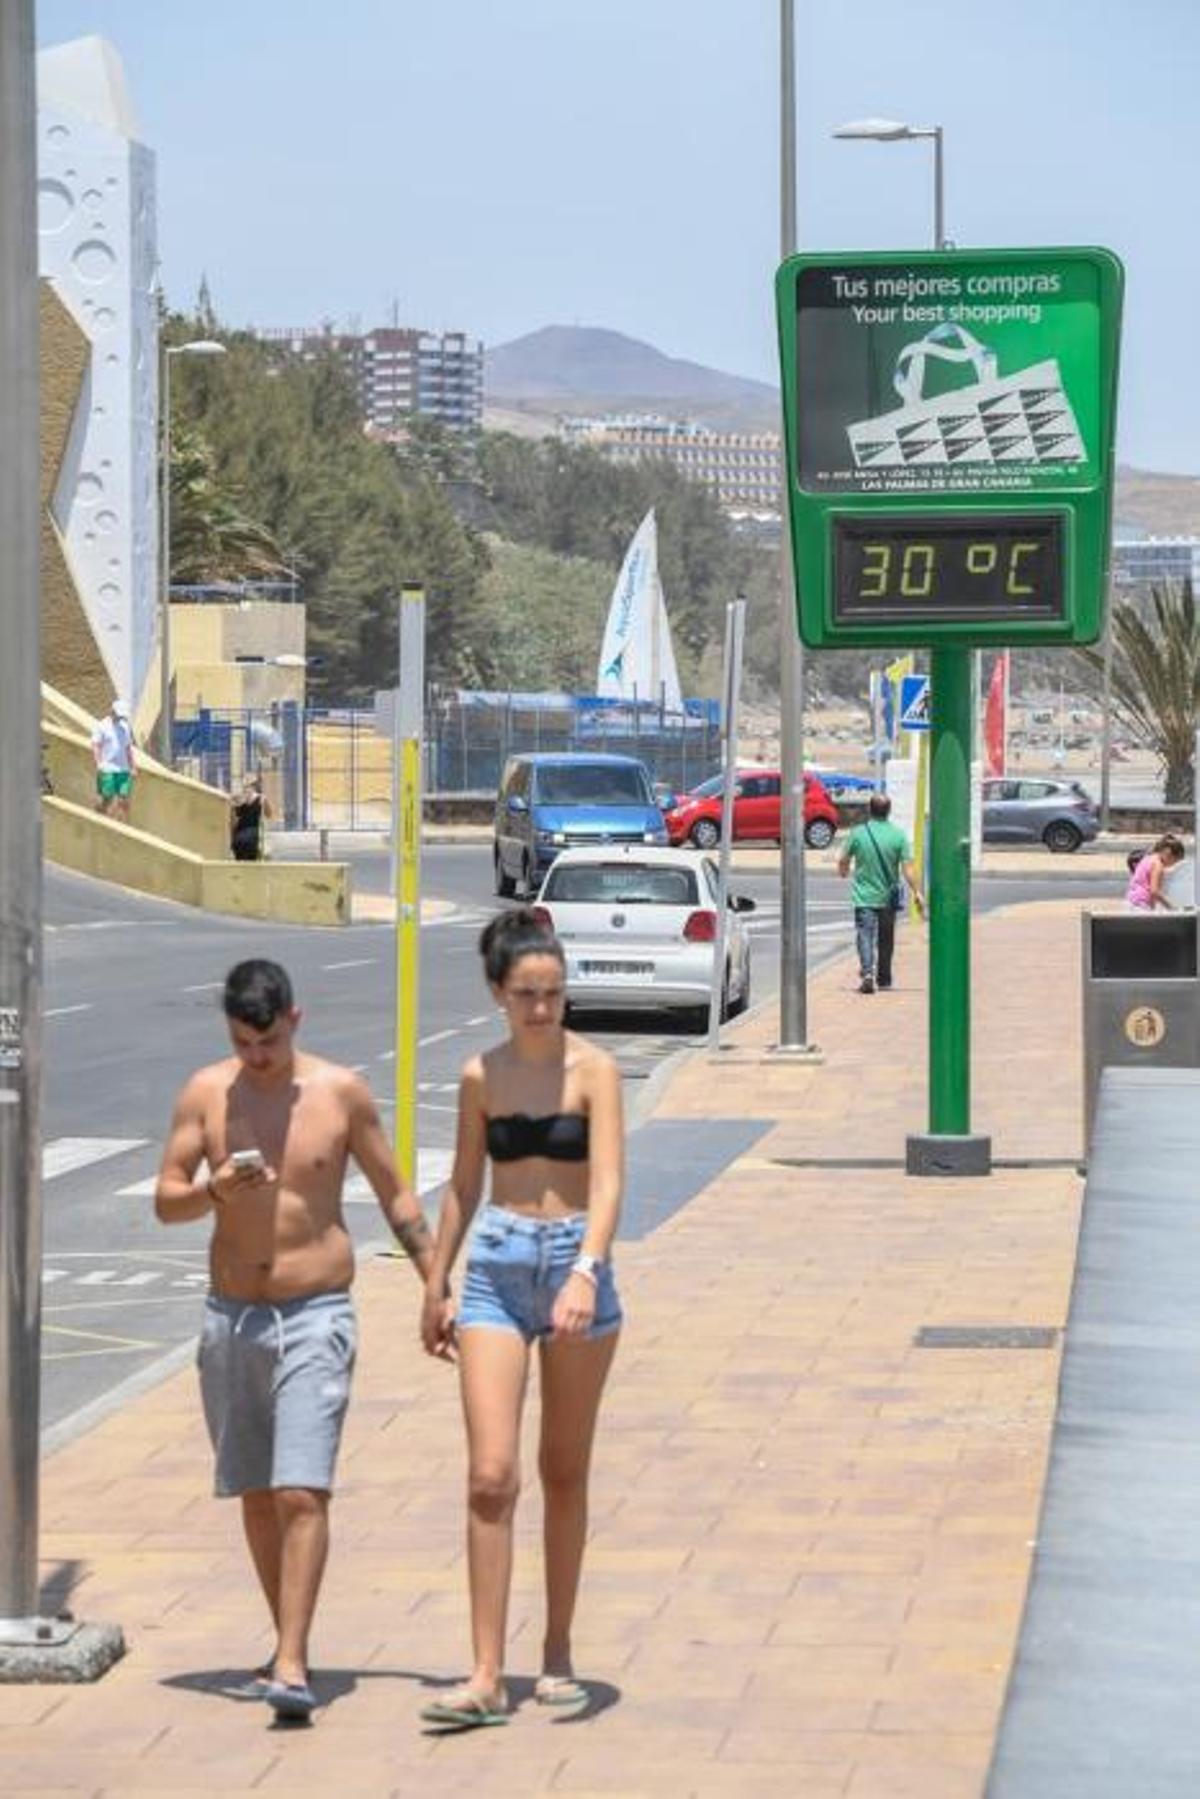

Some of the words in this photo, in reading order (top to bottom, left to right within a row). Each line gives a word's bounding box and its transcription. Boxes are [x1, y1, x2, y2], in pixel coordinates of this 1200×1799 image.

[832, 275, 868, 298] Tus
[874, 273, 961, 301] mejores
[967, 272, 1061, 299] compras
[853, 306, 899, 324] Your
[903, 305, 944, 322] best
[949, 302, 1041, 323] shopping
[862, 480, 882, 490] LAS
[885, 480, 928, 490] PALMAS
[931, 480, 945, 489] DE
[949, 479, 981, 488] GRAN
[983, 477, 1032, 488] CANARIA
[859, 545, 935, 597] 30
